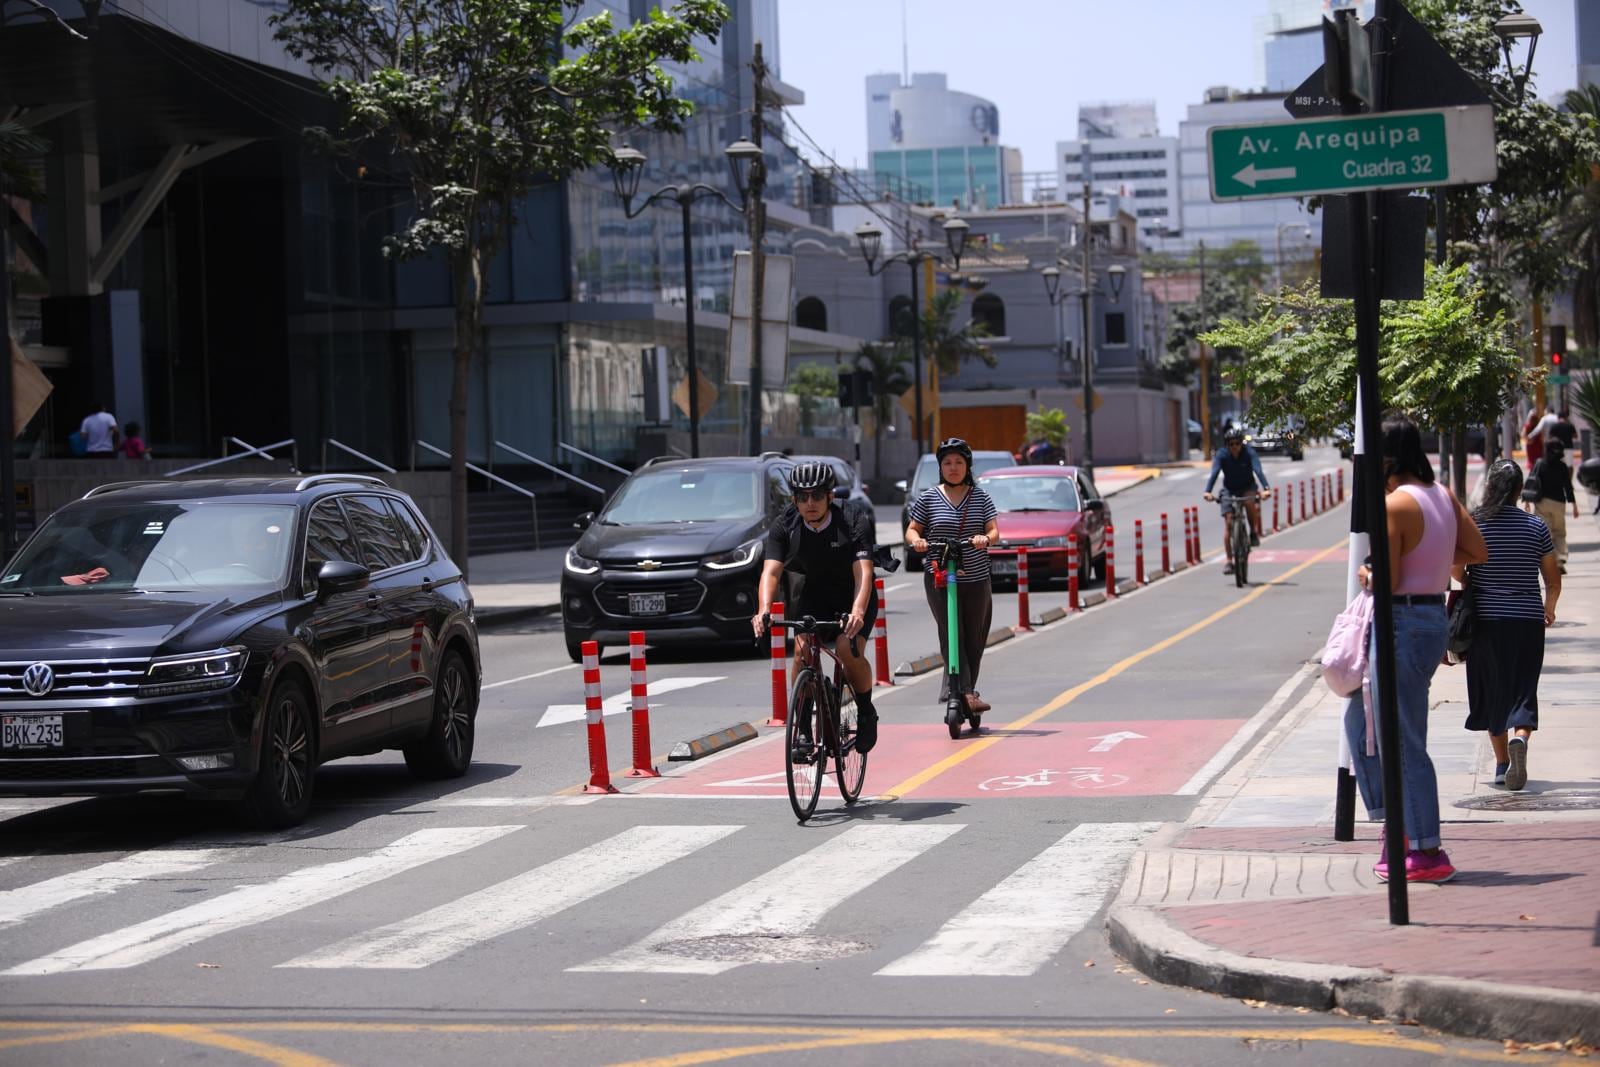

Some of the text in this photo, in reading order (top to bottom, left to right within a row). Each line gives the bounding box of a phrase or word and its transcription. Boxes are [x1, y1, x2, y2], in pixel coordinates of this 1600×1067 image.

[1295, 96, 1311, 106] MSI
[1318, 96, 1325, 106] P
[1238, 125, 1421, 155] Av. Arequipa
[1342, 154, 1433, 180] Cuadra 32
[5, 724, 62, 744] BKK-235
